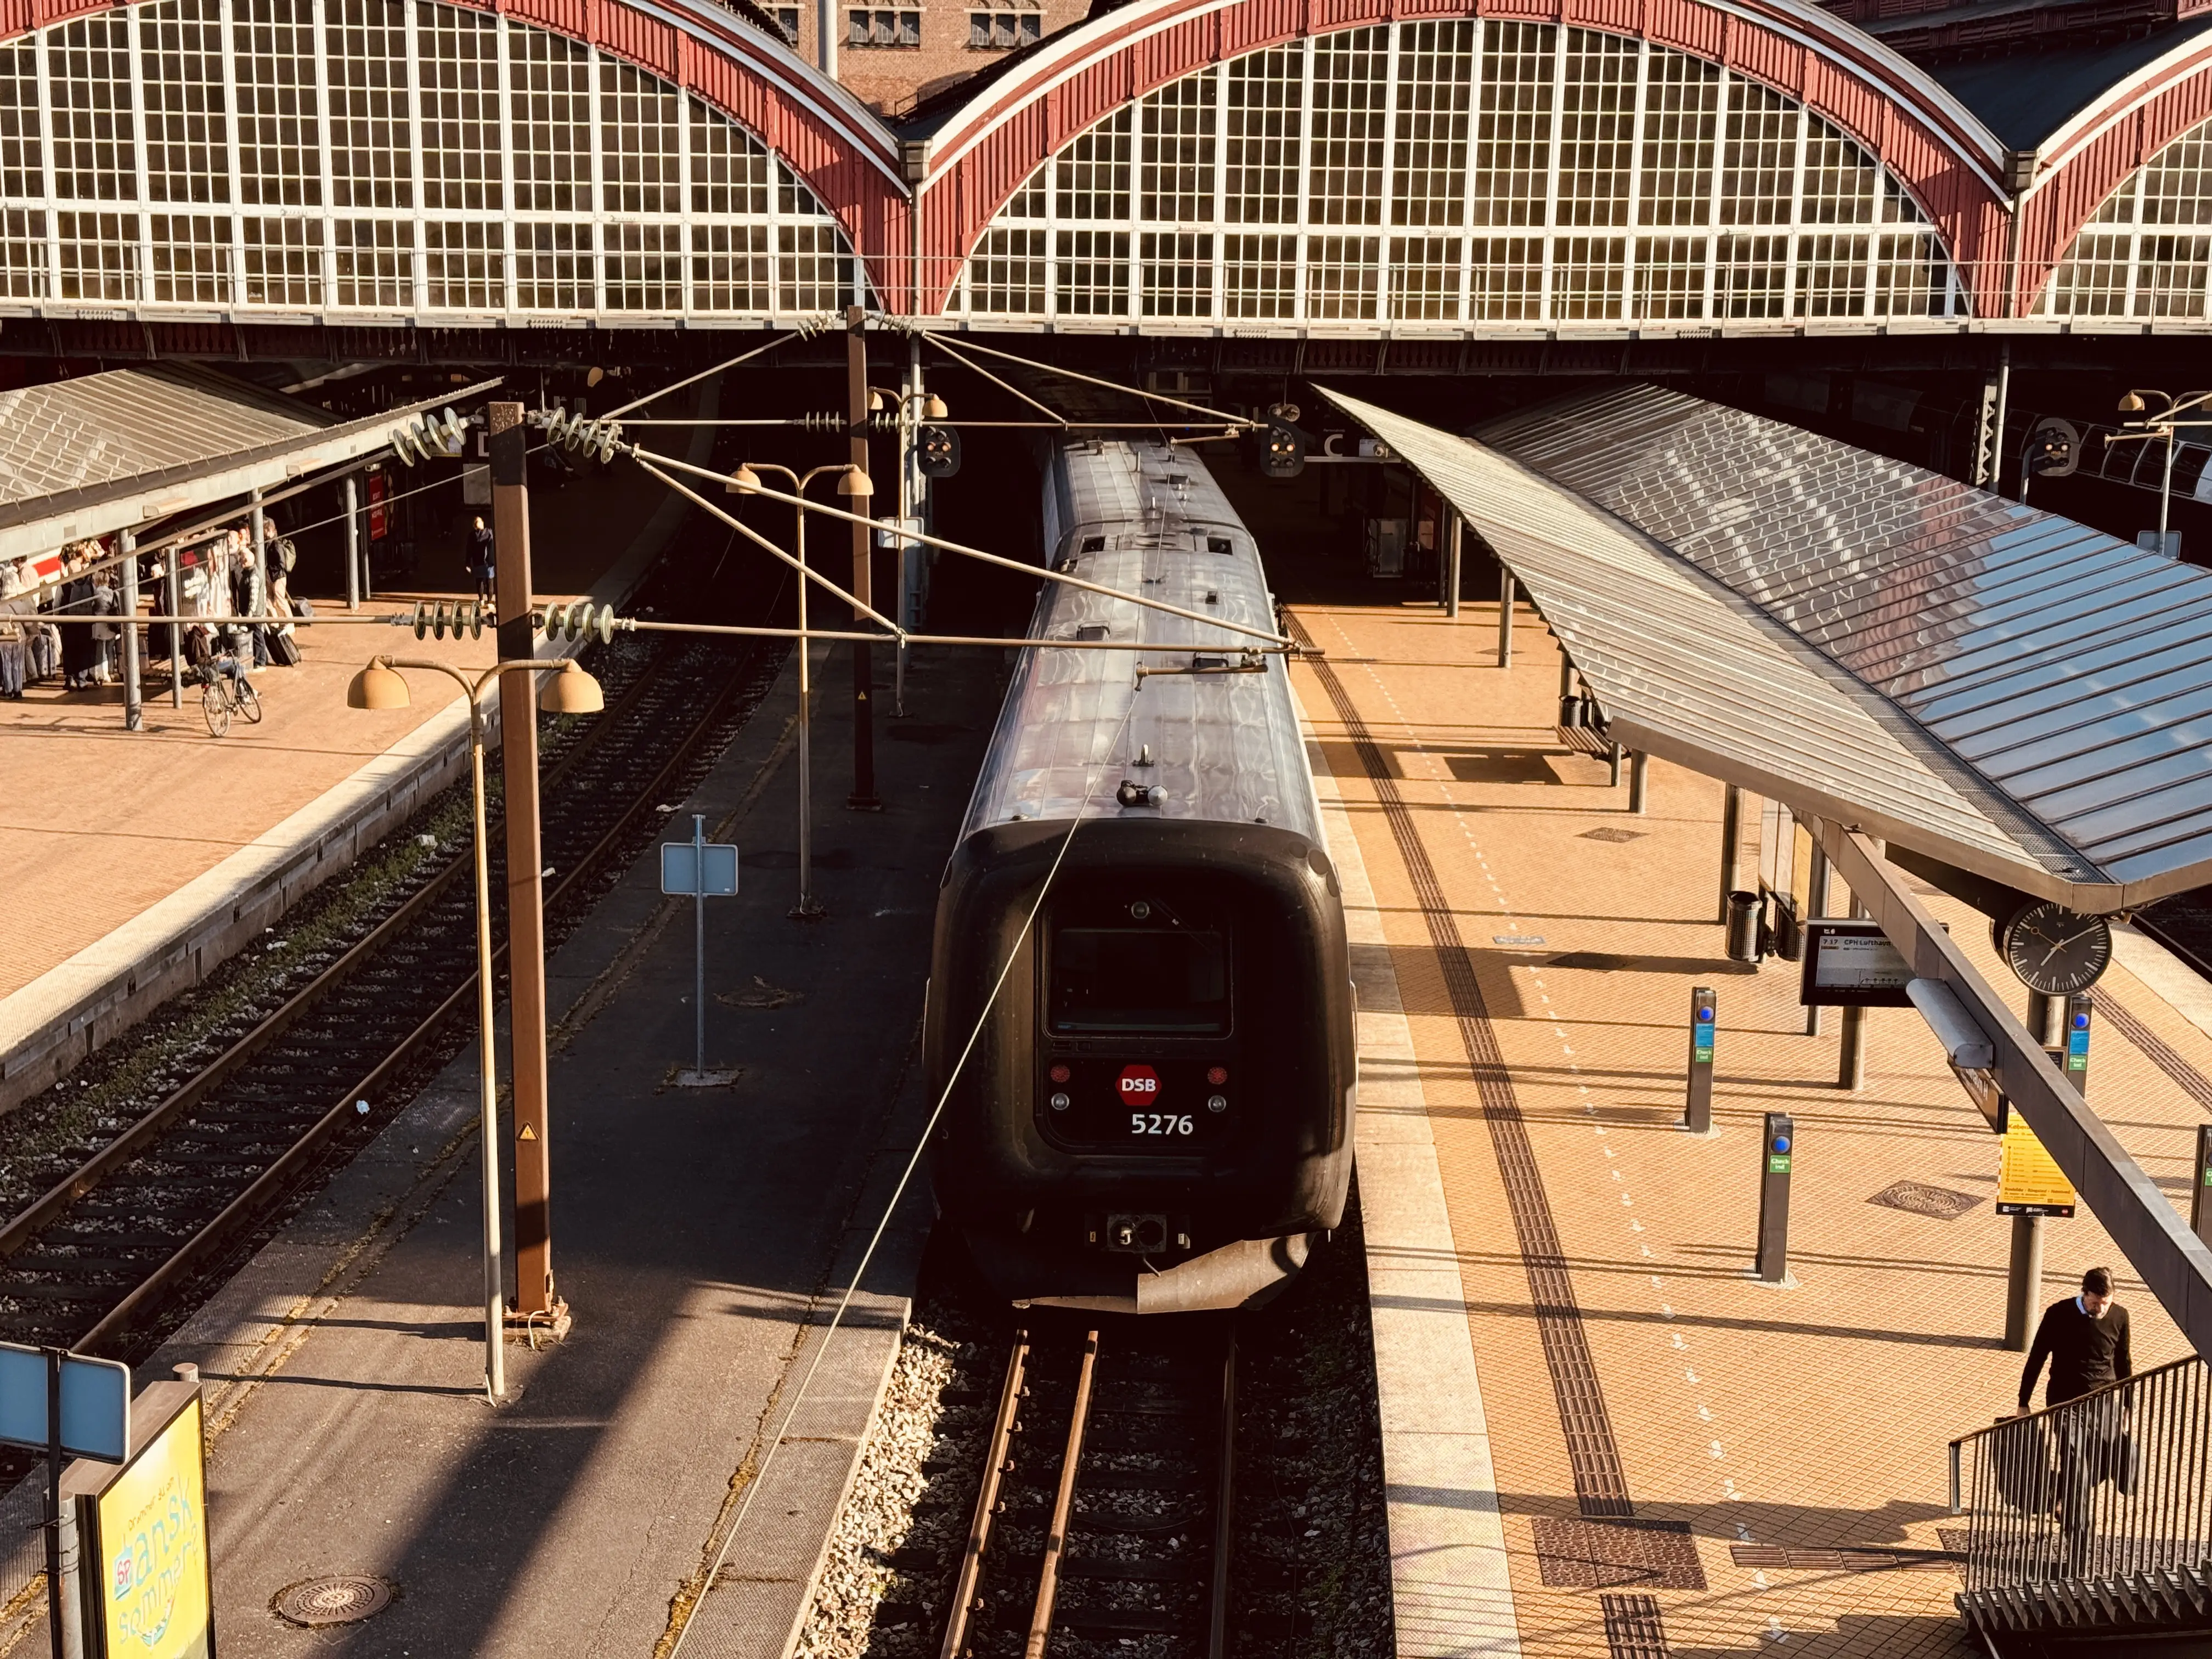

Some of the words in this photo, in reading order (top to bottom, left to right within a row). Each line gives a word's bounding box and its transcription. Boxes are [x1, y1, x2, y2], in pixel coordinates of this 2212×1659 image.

[1324, 433, 1343, 457] C
[1121, 1078, 1156, 1092] DSB
[1131, 1114, 1193, 1135] 5276
